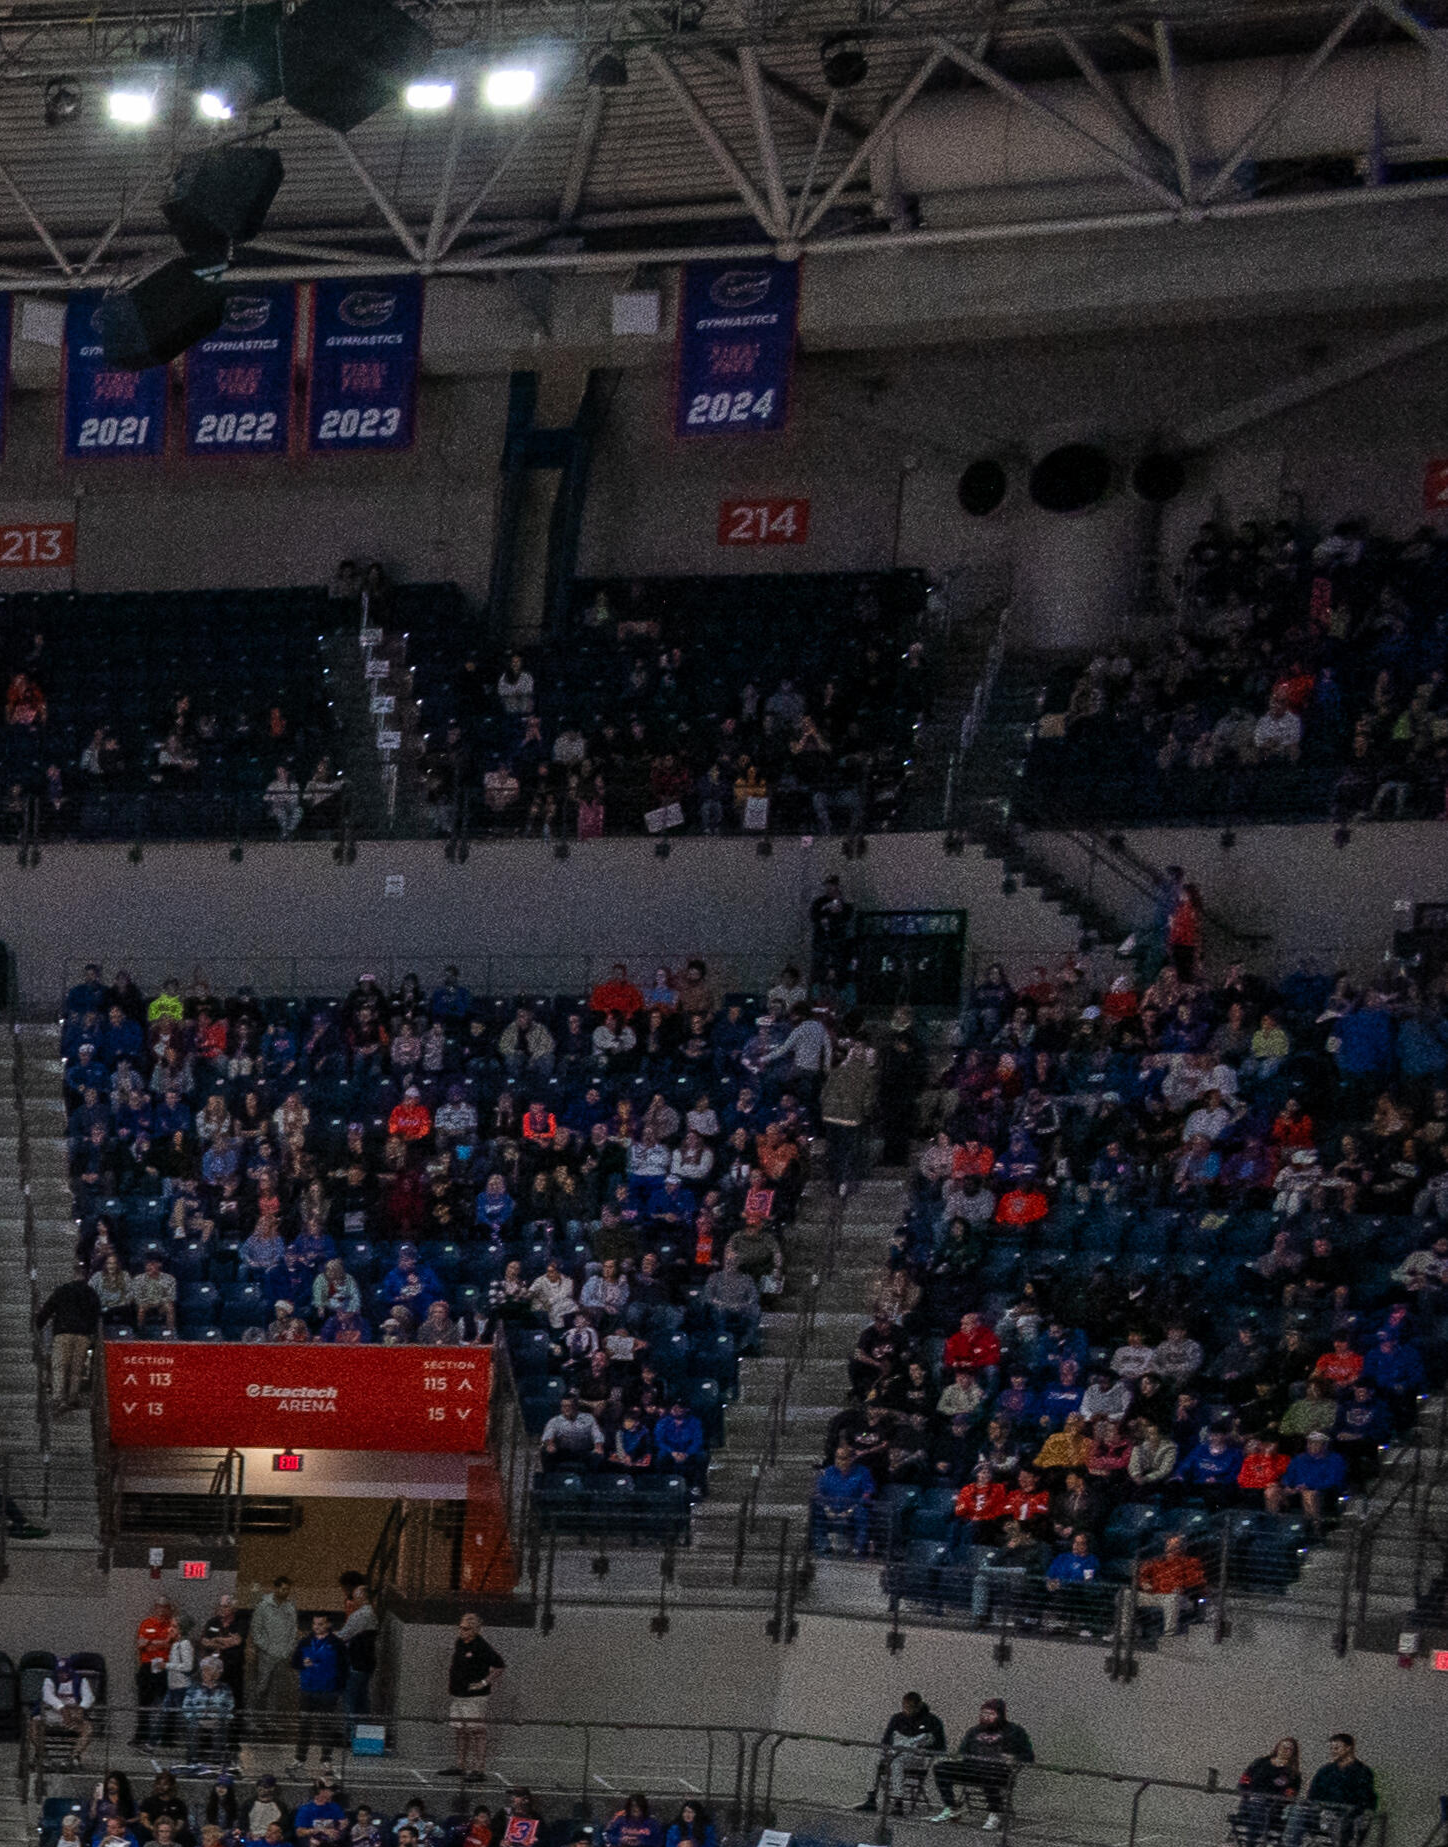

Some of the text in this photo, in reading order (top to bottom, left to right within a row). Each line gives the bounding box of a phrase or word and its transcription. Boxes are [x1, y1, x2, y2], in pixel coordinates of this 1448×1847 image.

[688, 390, 774, 425] 2024
[78, 416, 149, 446] 2021
[195, 414, 277, 443] 2022
[318, 409, 401, 440] 2023
[728, 505, 798, 539] 214
[0, 530, 62, 562] 213
[123, 1356, 175, 1365] SECTION
[424, 1361, 475, 1370] SECTION
[149, 1373, 172, 1387] 113
[423, 1377, 447, 1391] 115
[261, 1384, 338, 1399] Exactech
[148, 1402, 164, 1415] 13
[277, 1399, 336, 1413] ARENA
[428, 1407, 445, 1421] 15
